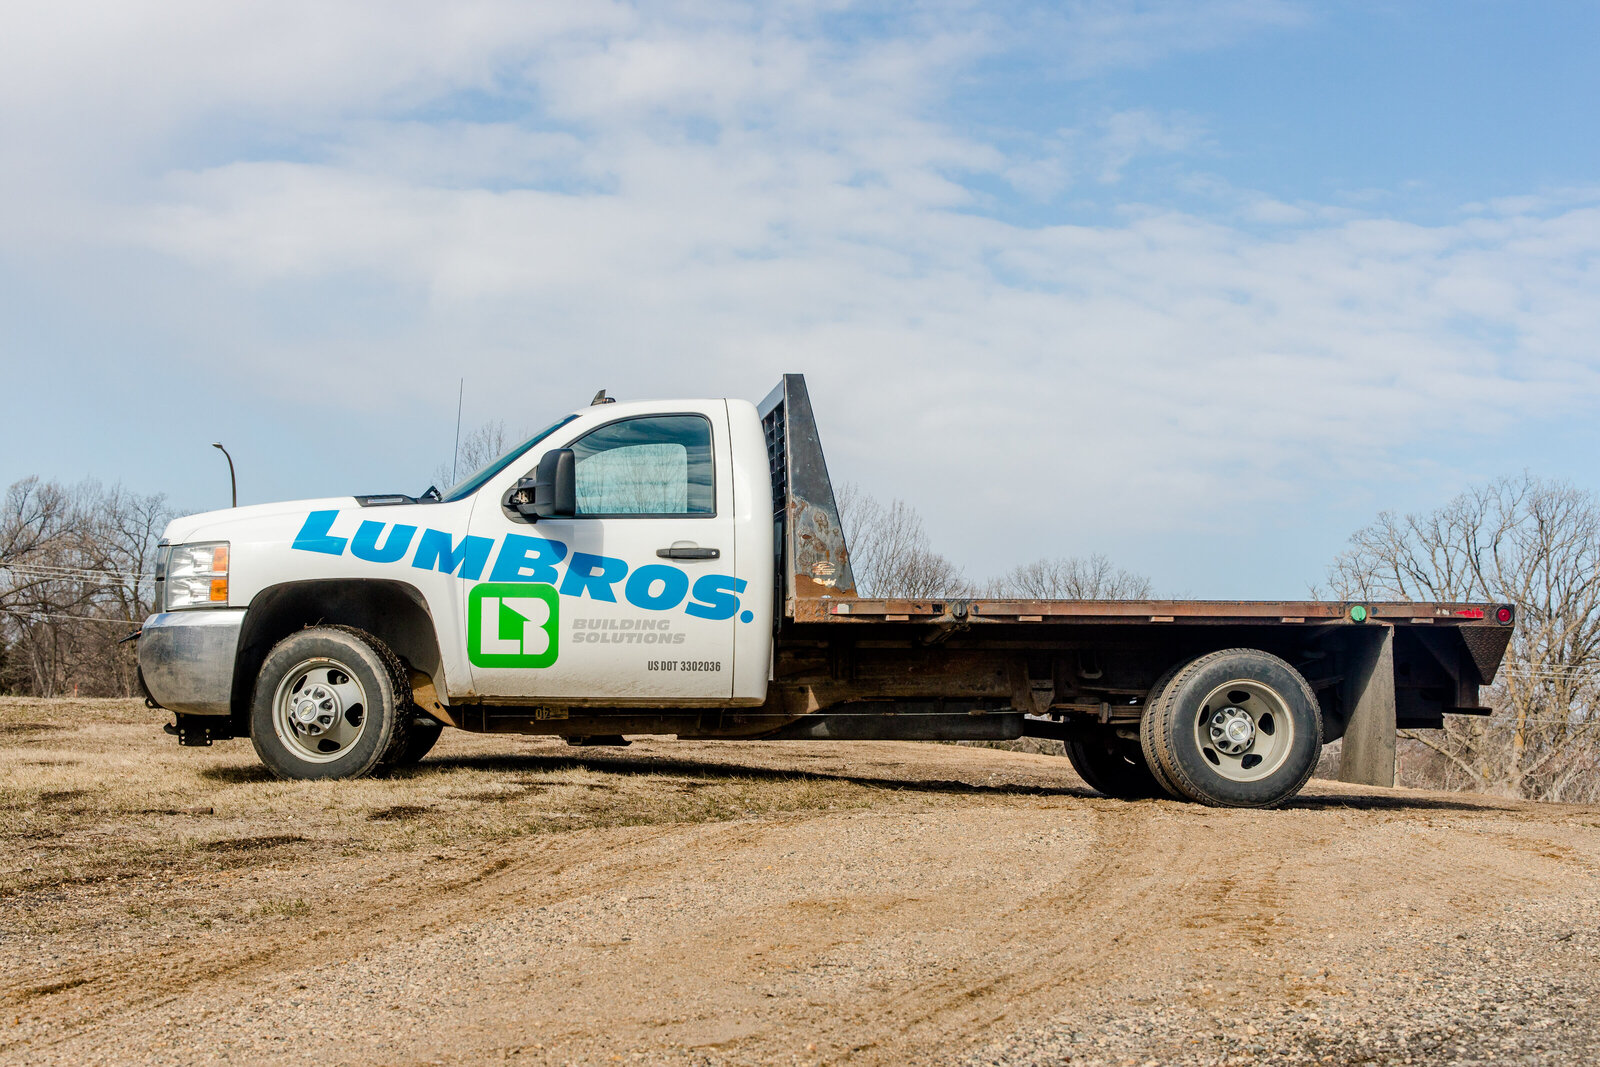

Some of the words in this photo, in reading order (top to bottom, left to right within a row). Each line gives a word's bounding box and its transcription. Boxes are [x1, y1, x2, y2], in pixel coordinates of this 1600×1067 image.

[292, 509, 755, 624] LUMBROS.
[480, 597, 551, 655] LB
[572, 618, 670, 631] BUILDING
[572, 632, 686, 644] SOLUTIONS
[647, 661, 659, 671] US
[660, 661, 678, 671] DOT
[680, 661, 721, 672] 3302036
